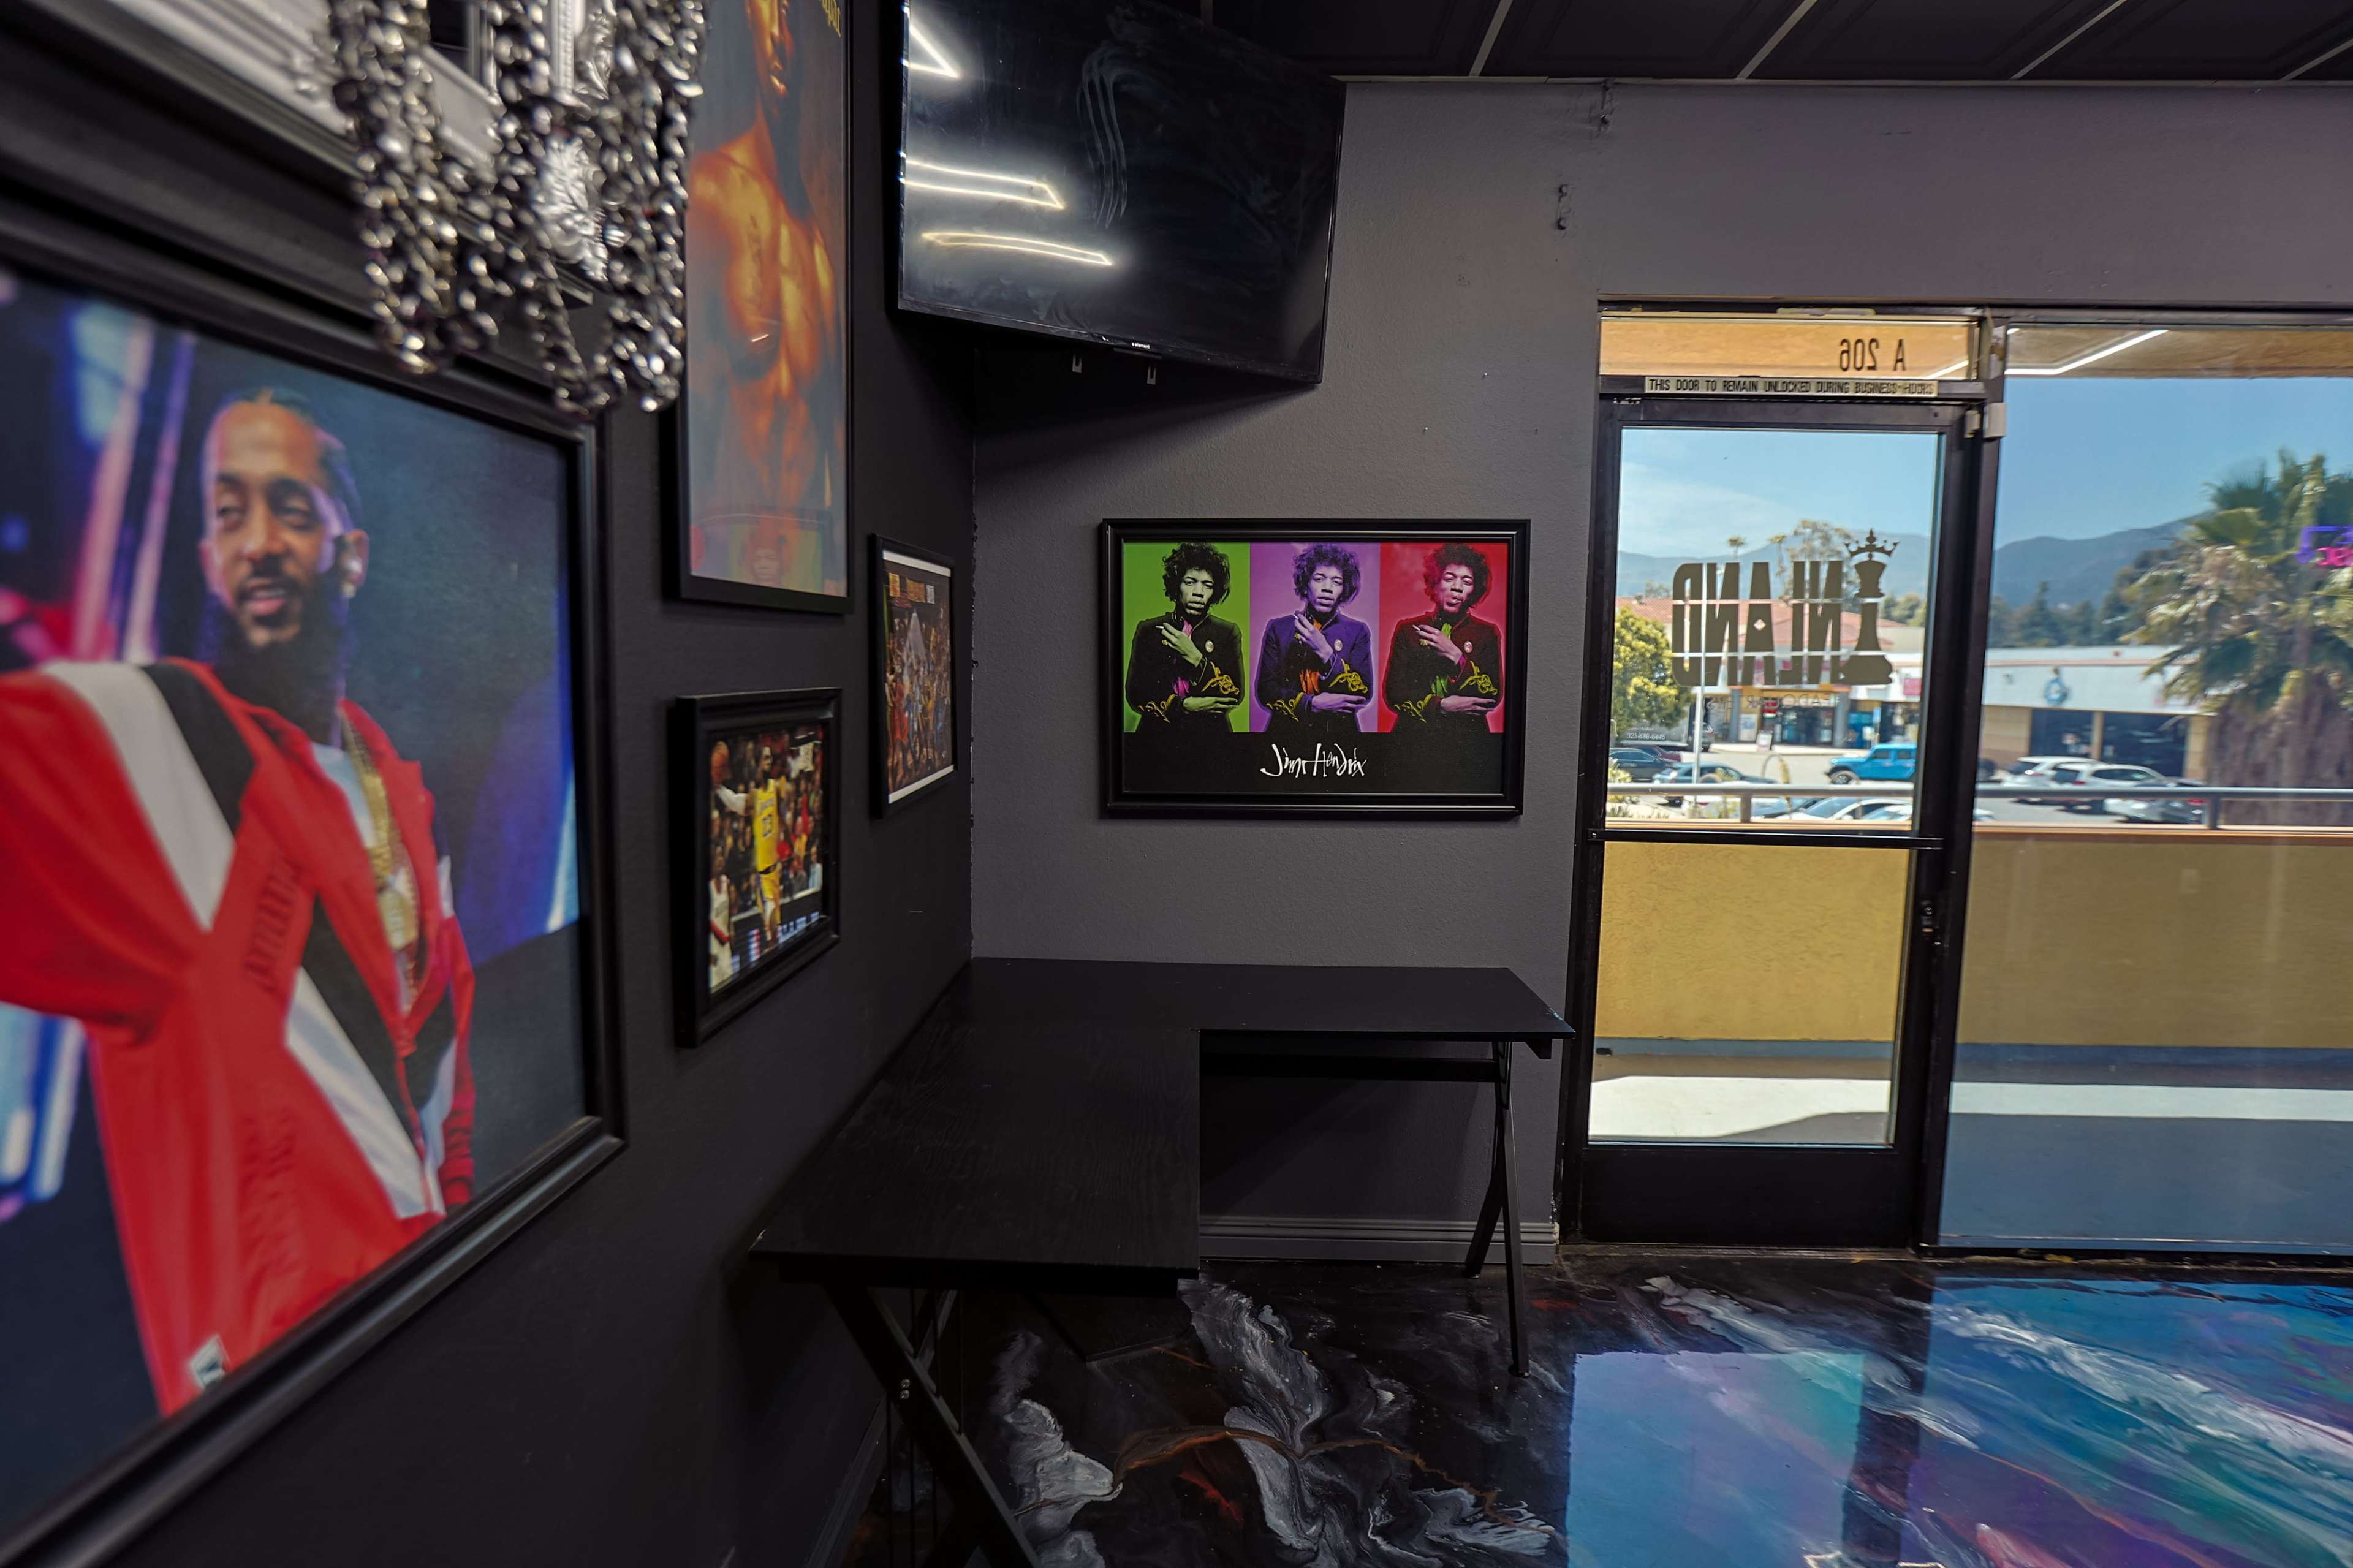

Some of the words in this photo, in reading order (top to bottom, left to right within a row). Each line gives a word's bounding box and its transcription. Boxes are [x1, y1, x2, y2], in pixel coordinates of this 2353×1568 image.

[1649, 379, 1670, 391] THIS
[1676, 379, 1699, 391] DOOR
[1705, 380, 1717, 392] TO
[1723, 380, 1759, 392] REMAIN
[1765, 381, 1811, 393] UNLOCKED
[1817, 381, 1849, 393] DURING
[1855, 382, 1898, 394] BUSINESS
[1311, 742, 1368, 778] Hendrix
